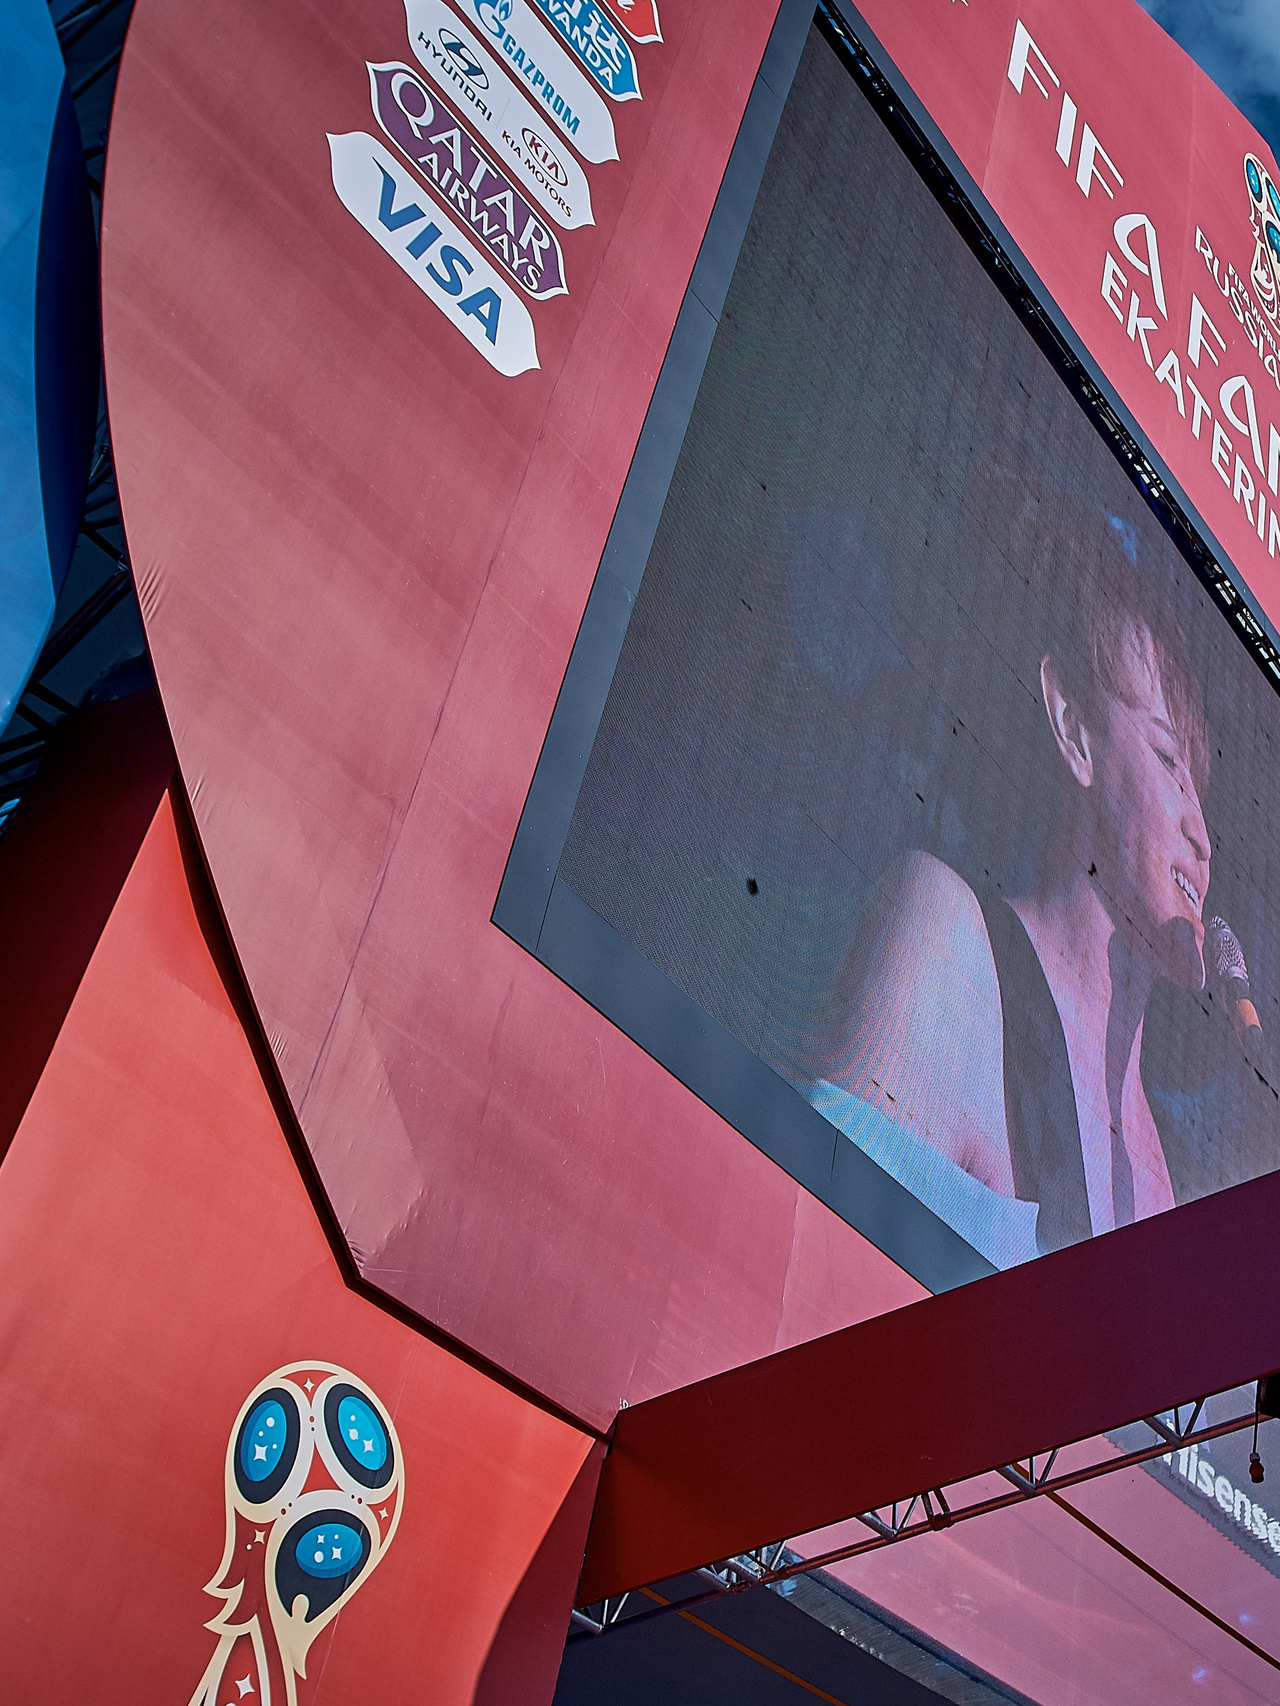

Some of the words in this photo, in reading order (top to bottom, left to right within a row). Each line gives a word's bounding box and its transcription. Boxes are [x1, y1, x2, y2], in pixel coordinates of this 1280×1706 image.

[417, 31, 493, 122] HYUNDAI
[502, 34, 581, 135] GAZPROM
[391, 72, 550, 271] QATAR
[501, 130, 523, 159] KIA
[524, 158, 573, 218] MOTORS
[529, 136, 560, 179] KIA
[1007, 18, 1168, 321] FIFA
[372, 156, 503, 347] VISA
[418, 152, 542, 291] AIRWAYS
[1195, 225, 1280, 391] RUSSIA
[1228, 262, 1251, 308] FIFA
